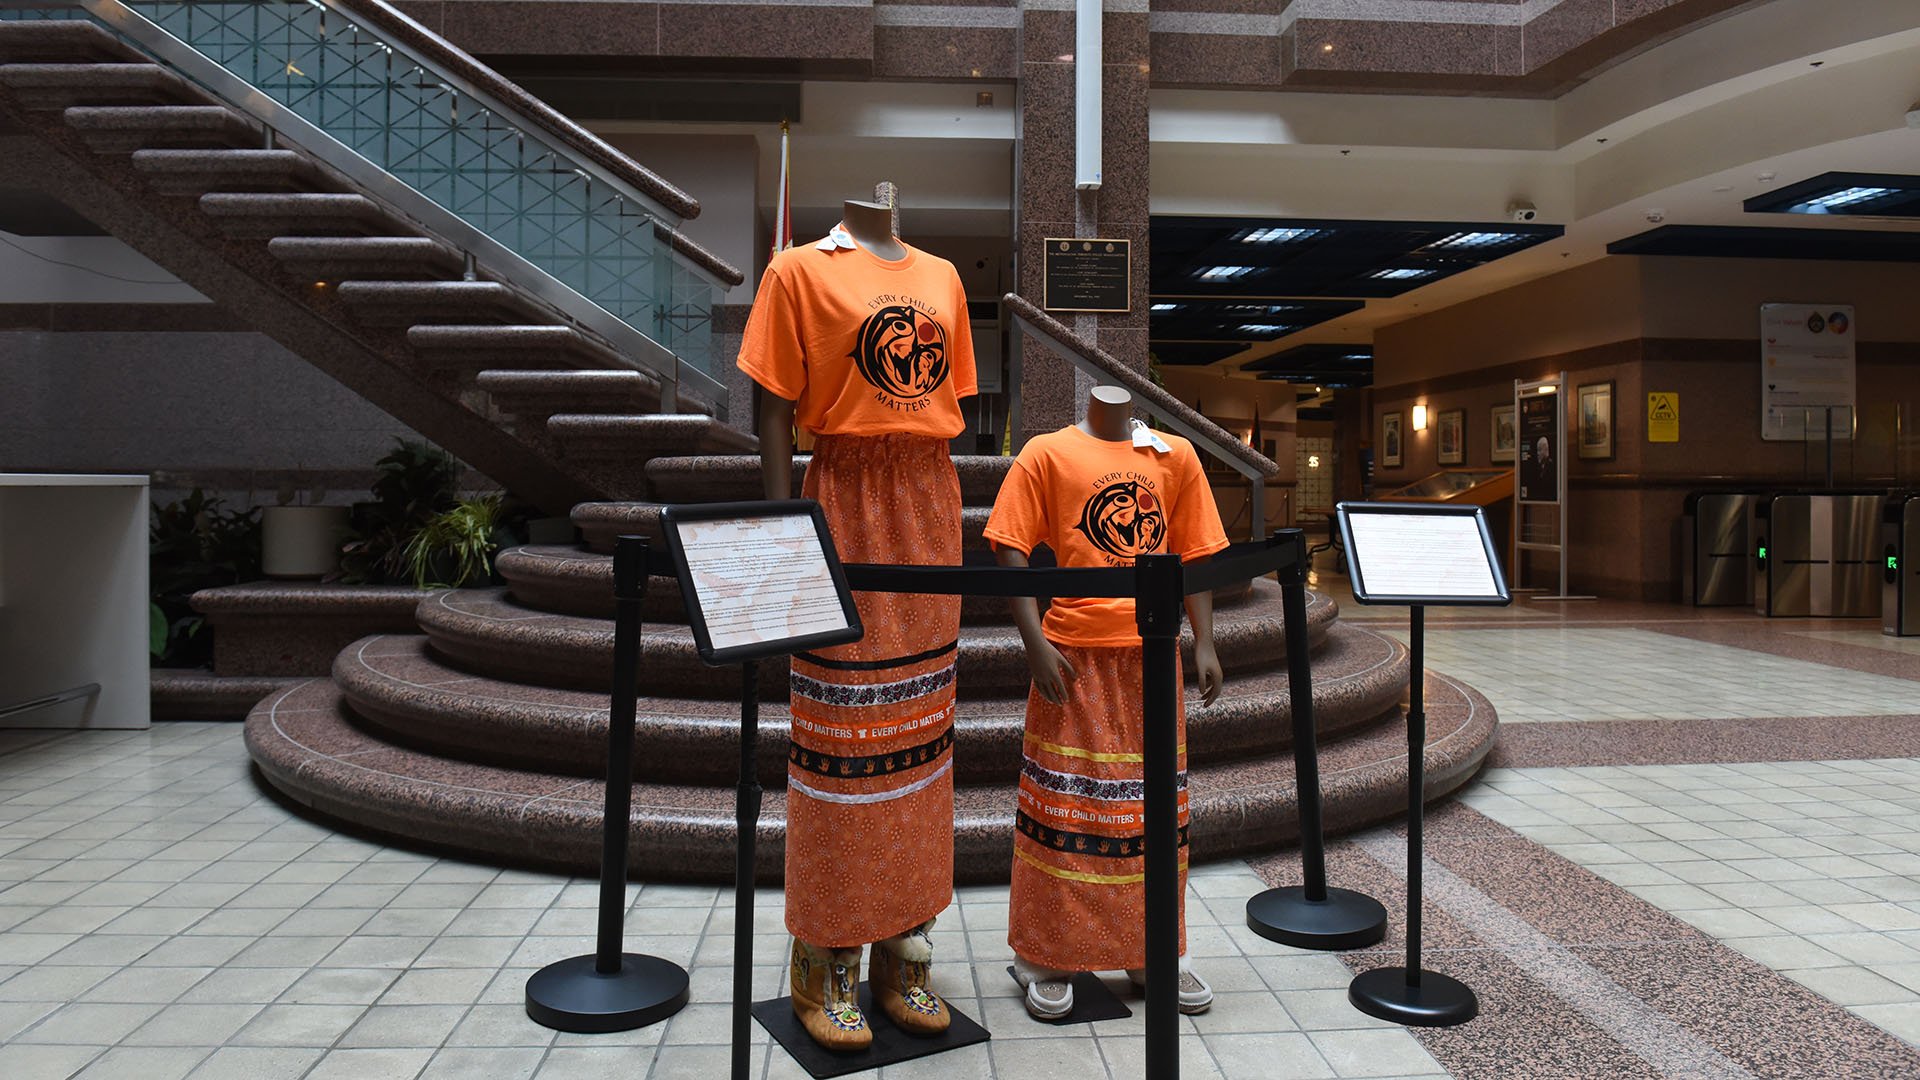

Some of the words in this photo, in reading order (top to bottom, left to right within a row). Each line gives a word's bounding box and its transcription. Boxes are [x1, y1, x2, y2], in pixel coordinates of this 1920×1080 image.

[868, 294, 897, 310] EVERY
[900, 295, 937, 316] CHILD
[874, 391, 931, 412] MATTERS
[1092, 472, 1122, 490] EVERY
[1126, 471, 1156, 490] CHILD
[795, 717, 813, 732] CHILD
[814, 725, 853, 739] MATTERS
[871, 725, 898, 738] EVERY
[899, 719, 919, 733] CHILD
[1044, 805, 1070, 818] EVERY
[1071, 809, 1096, 822] CHILD
[1099, 814, 1135, 825] MATTERS
